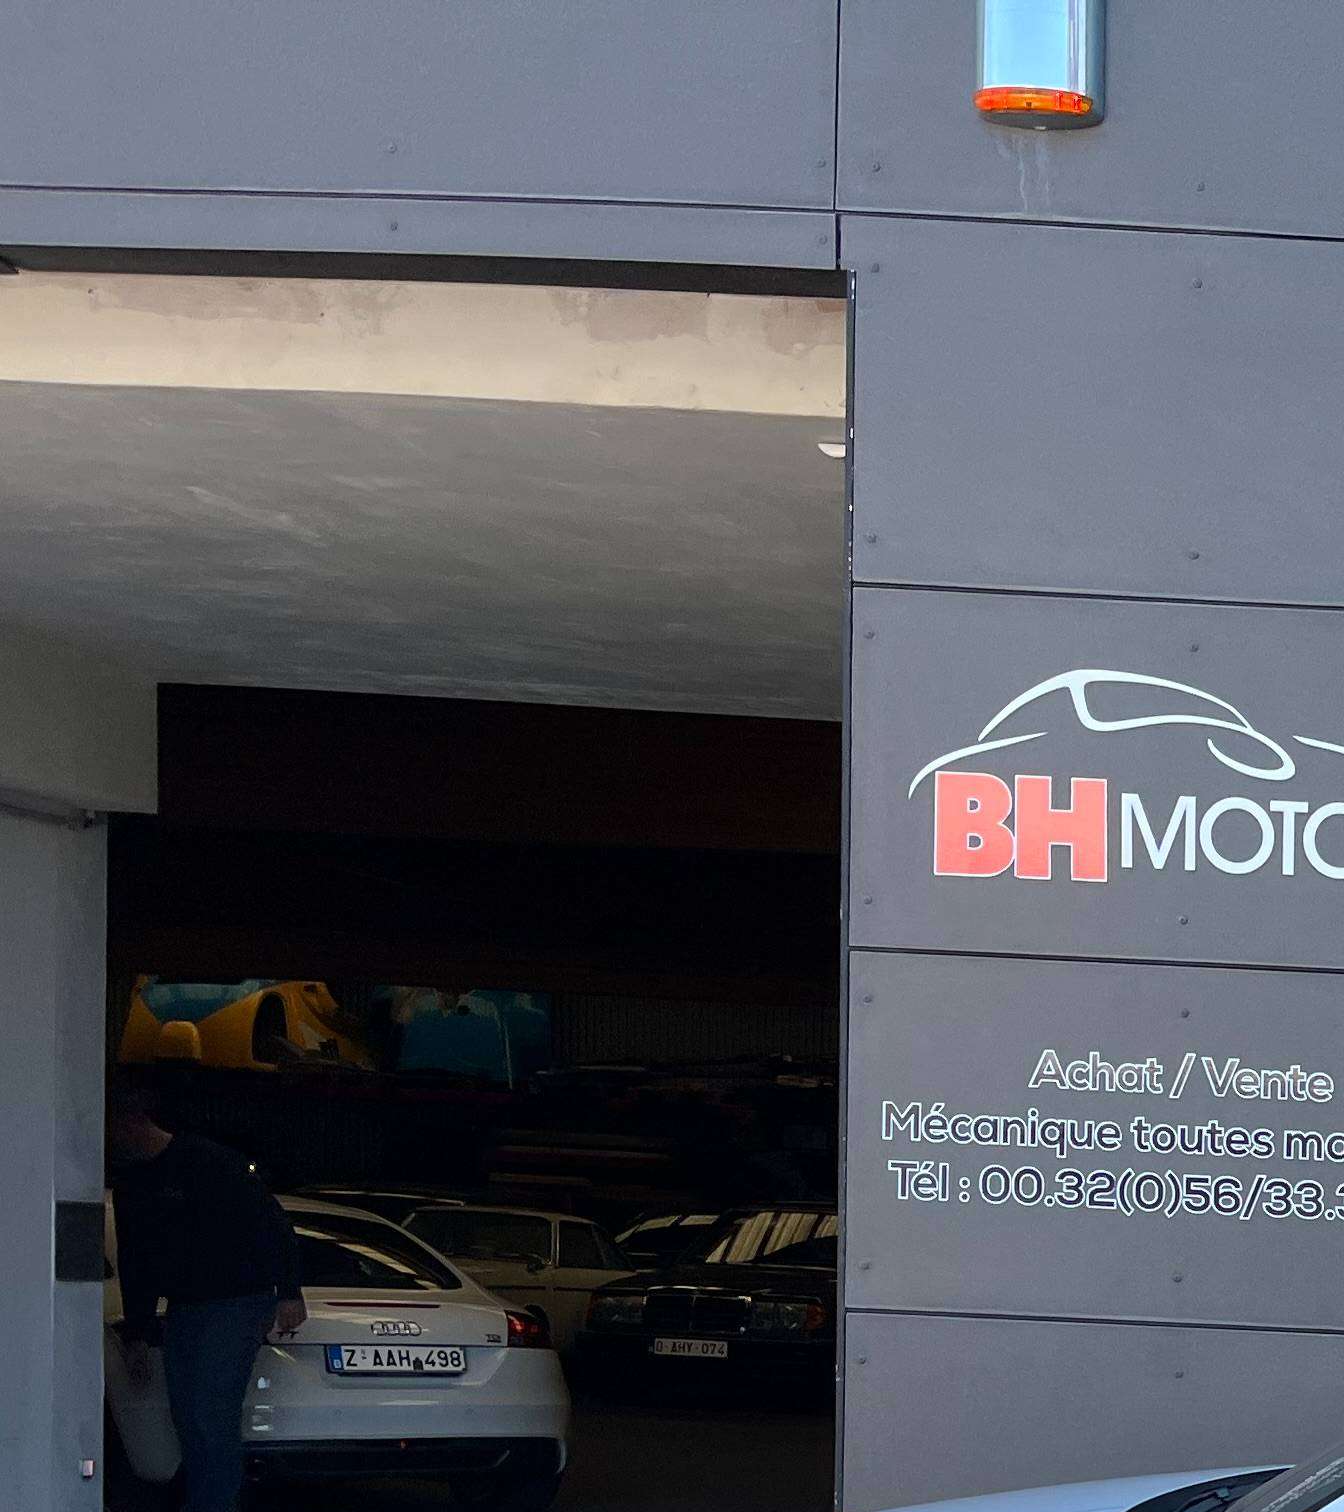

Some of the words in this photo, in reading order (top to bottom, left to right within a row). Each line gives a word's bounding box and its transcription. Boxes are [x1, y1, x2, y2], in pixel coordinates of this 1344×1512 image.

[933, 771, 1109, 883] BH
[1028, 1049, 1164, 1094] Achat
[1201, 1057, 1334, 1102] Vente
[881, 1101, 1122, 1158] Mécanique
[1130, 1116, 1275, 1158] toutes
